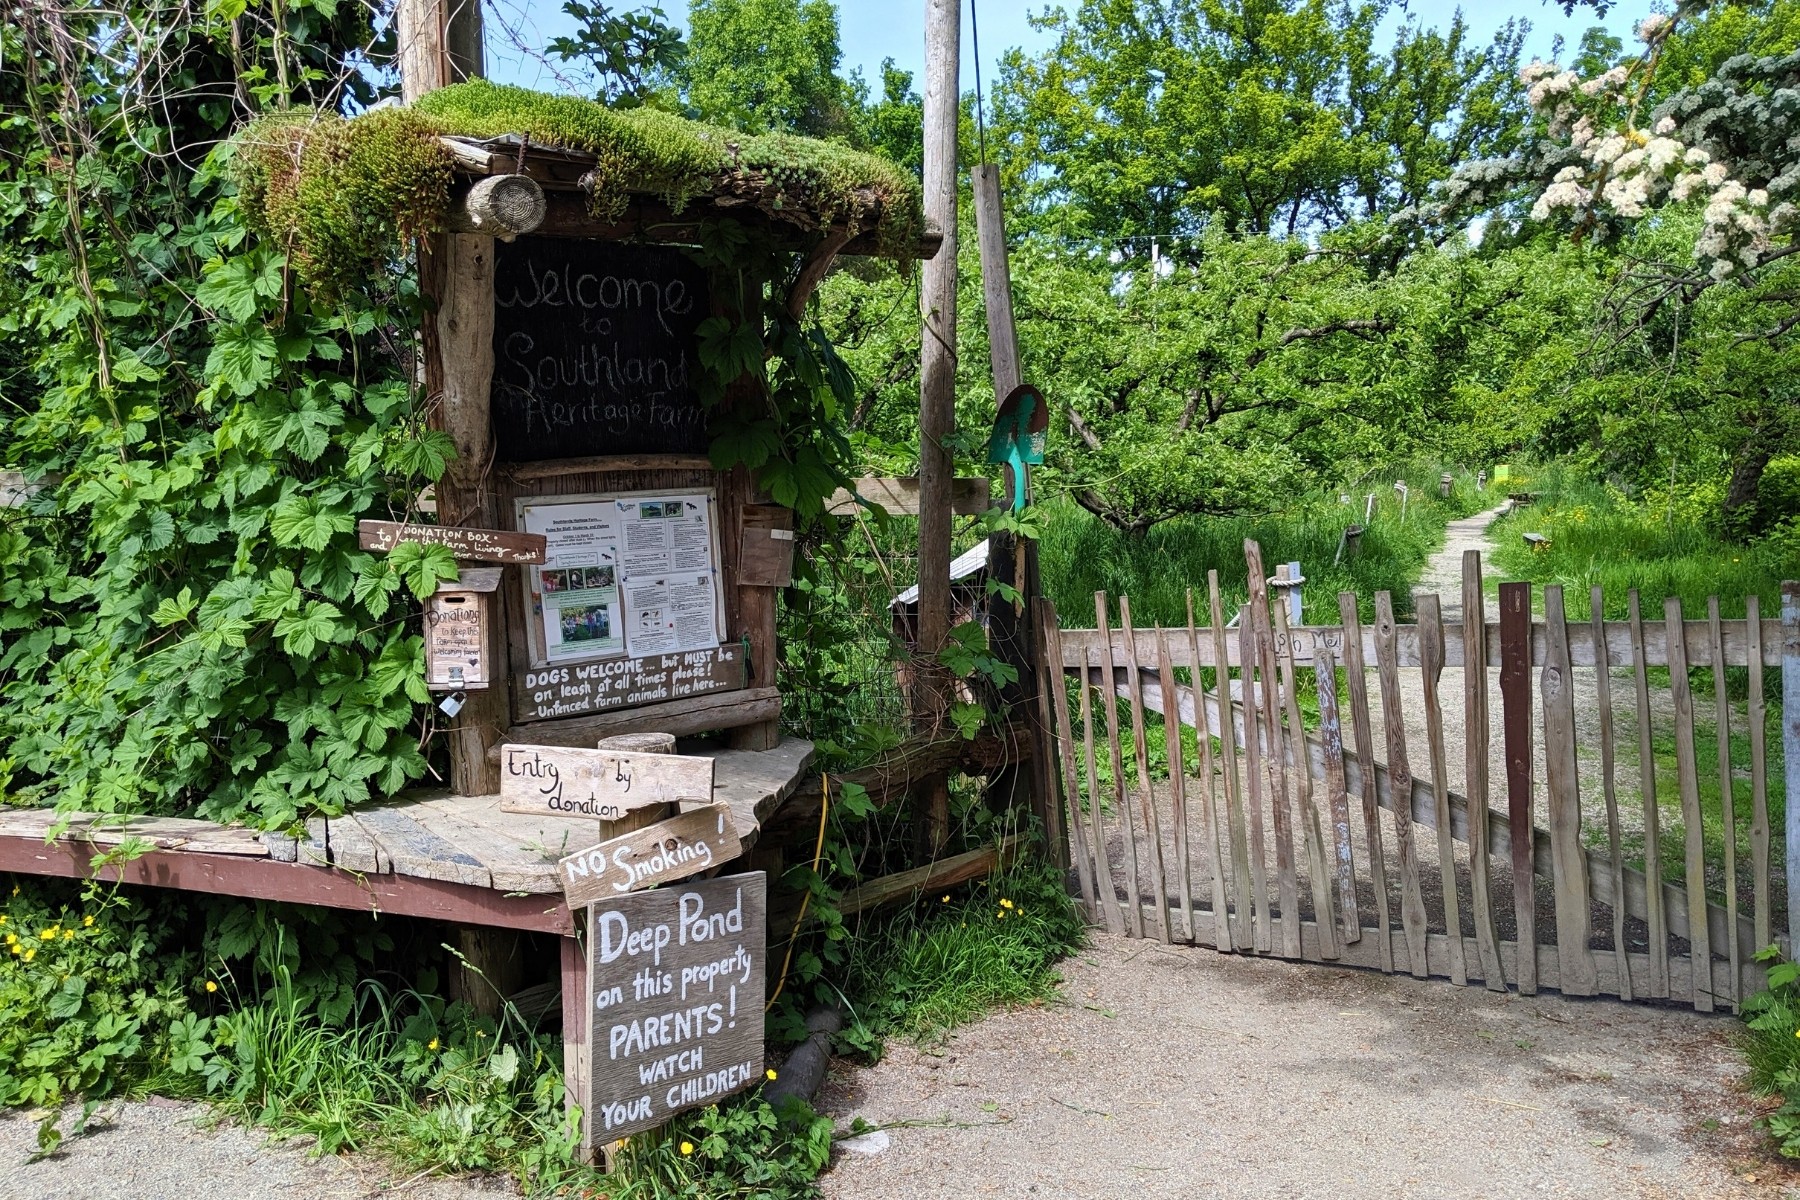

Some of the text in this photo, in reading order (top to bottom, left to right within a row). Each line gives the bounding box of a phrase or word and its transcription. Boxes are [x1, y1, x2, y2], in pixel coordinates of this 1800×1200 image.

[494, 256, 693, 337] Welcome
[579, 311, 611, 335] to
[526, 391, 708, 434] Heritage Farm
[370, 542, 387, 551] and
[376, 528, 392, 542] to
[442, 538, 468, 549] farm
[474, 542, 512, 558] living
[404, 527, 463, 540] DONATION
[526, 668, 569, 689] DOGS
[662, 655, 680, 668] but
[684, 650, 714, 664] MUST
[718, 648, 733, 662] be
[534, 663, 712, 703] on leash at all times please!
[538, 696, 590, 718] Unfenced
[594, 694, 622, 709] farm
[628, 688, 667, 703] animals
[672, 681, 690, 697] live
[508, 750, 631, 794] Entry by
[548, 782, 619, 818] donation
[566, 850, 607, 884] NO
[598, 887, 742, 966] Deep Pond
[596, 944, 752, 1010] on this property
[610, 984, 736, 1060] PARENTS!
[638, 1046, 704, 1086] WATCH
[601, 1060, 752, 1130] YOUR CHILDREN
